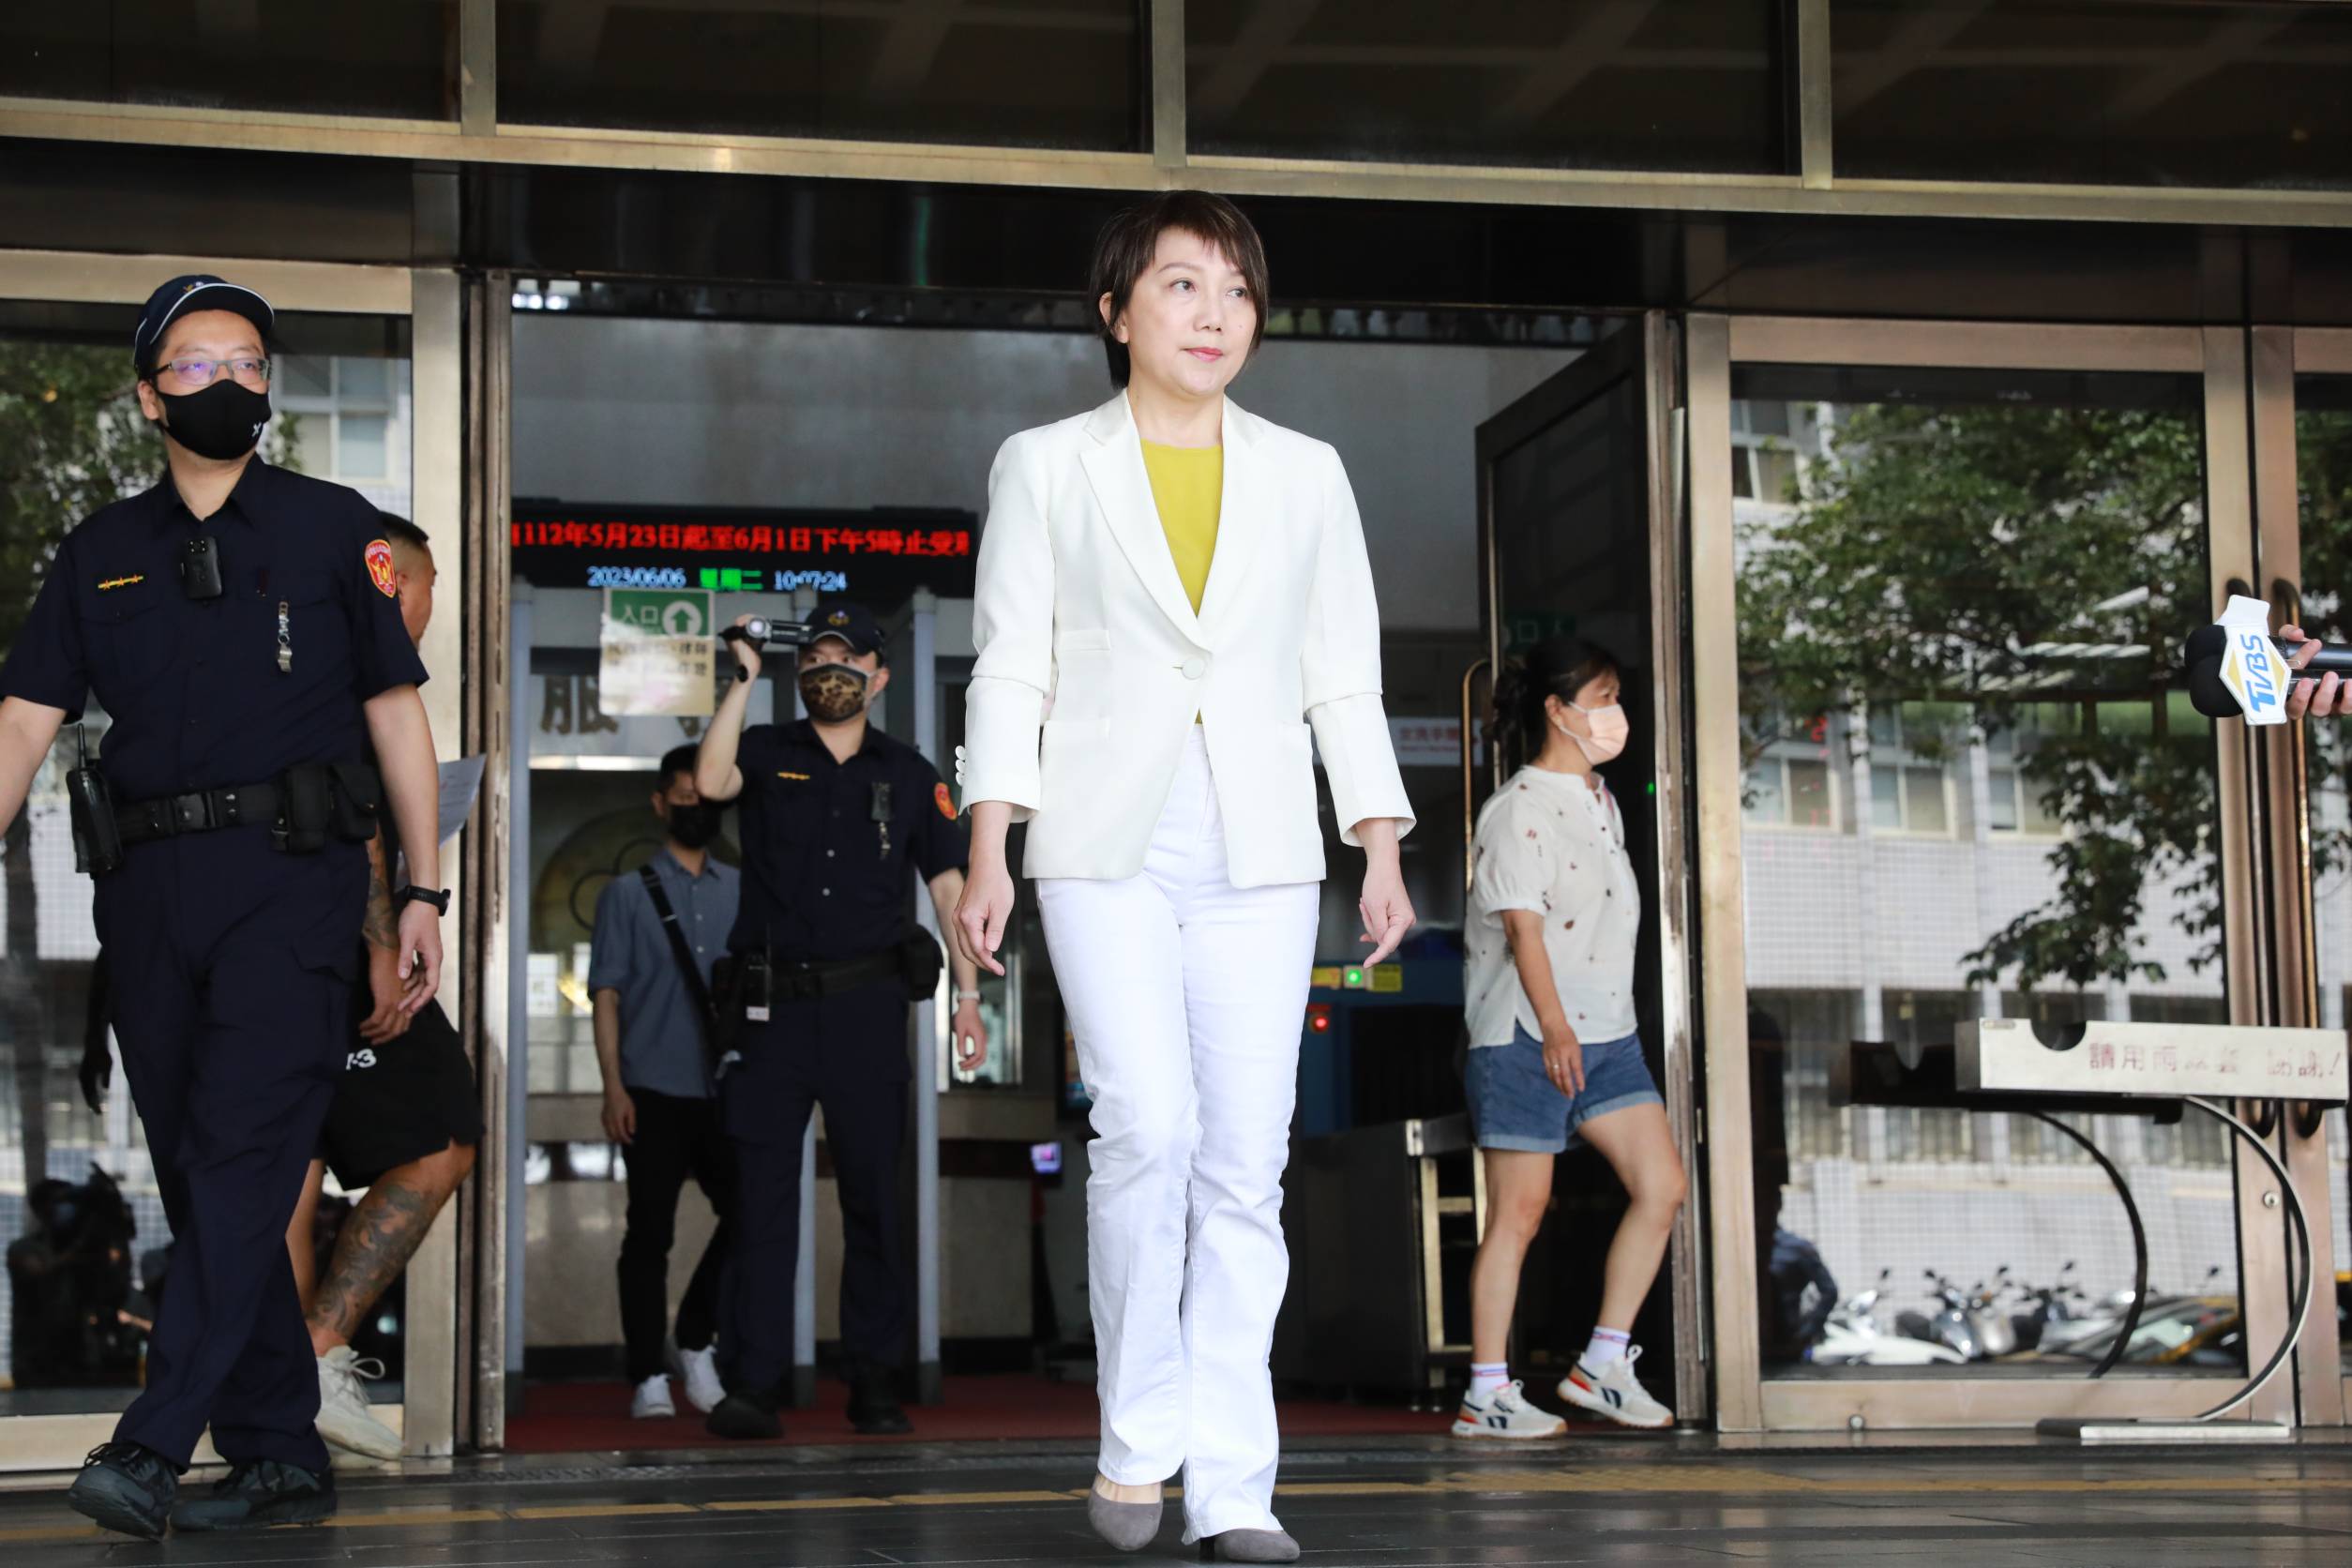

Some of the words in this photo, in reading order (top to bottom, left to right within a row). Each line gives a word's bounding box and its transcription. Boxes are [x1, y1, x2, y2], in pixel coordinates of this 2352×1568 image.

[587, 566, 686, 588] 2023/06/06
[621, 604, 659, 626] 入口
[2239, 634, 2276, 713] TVBS
